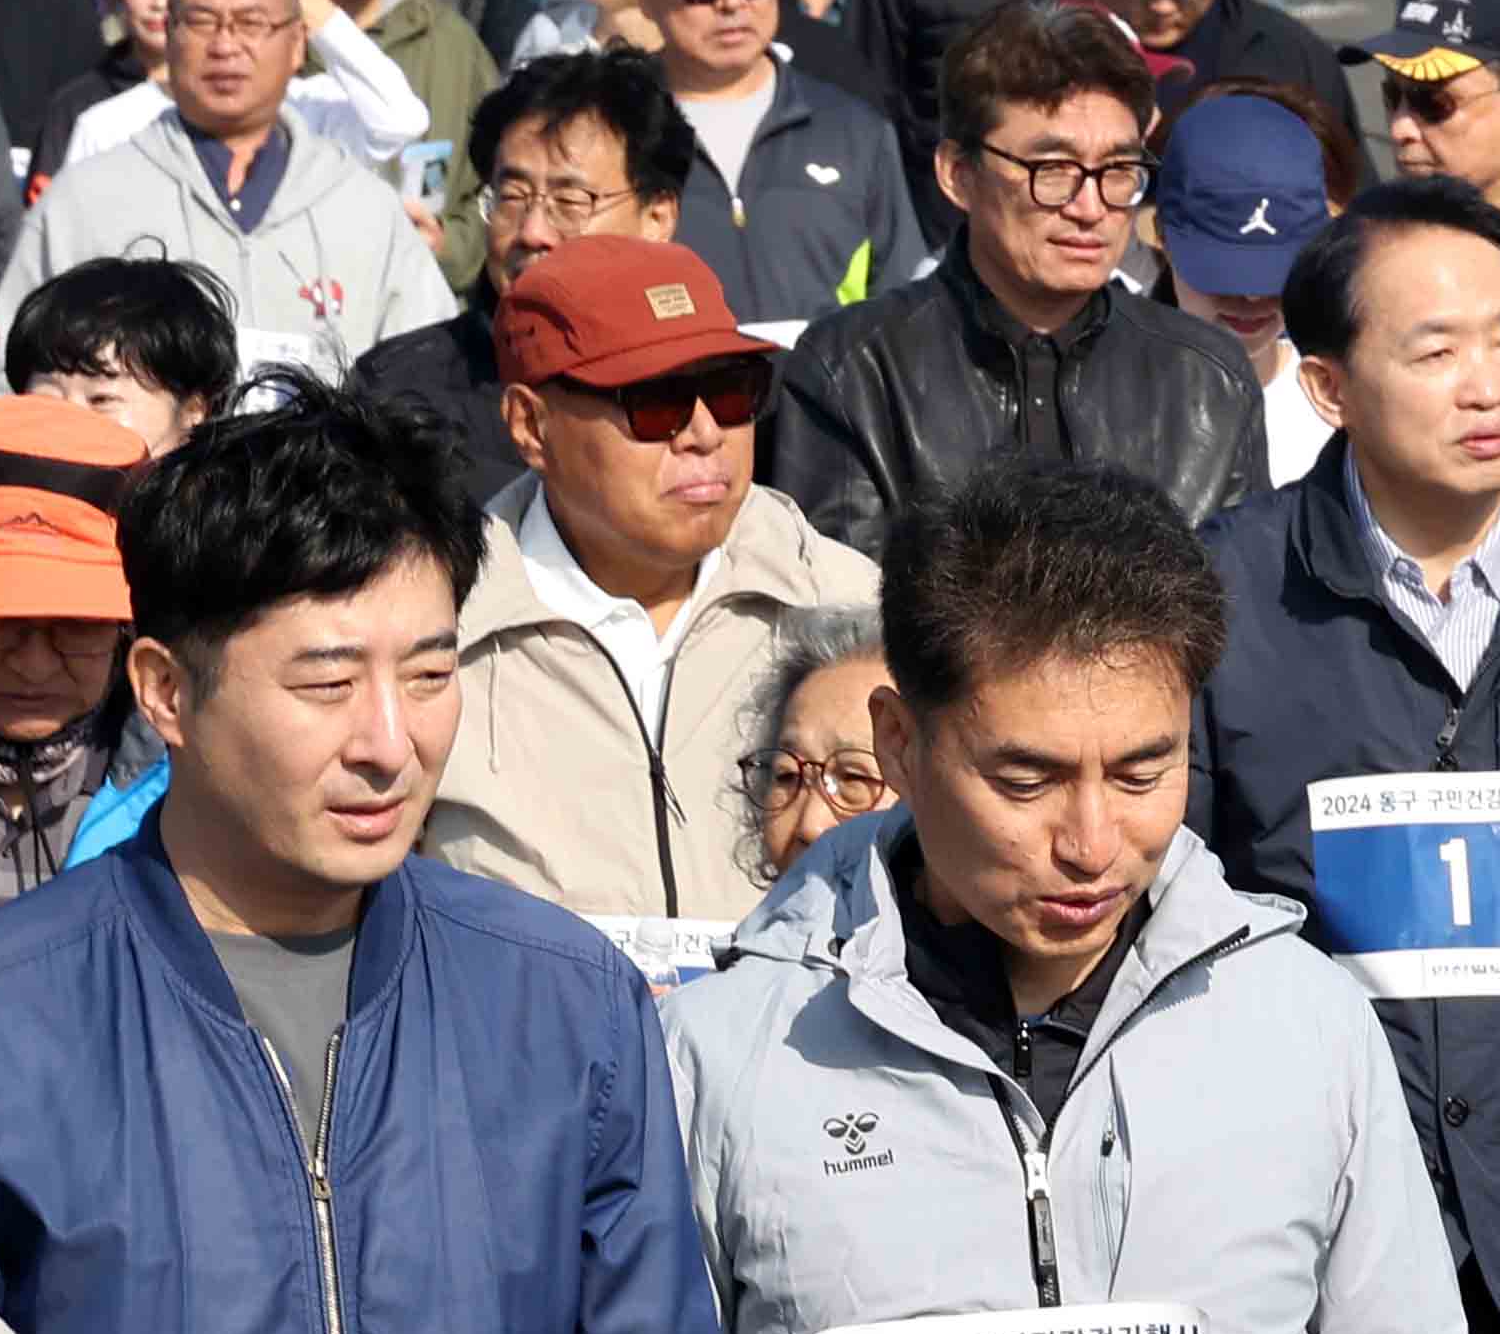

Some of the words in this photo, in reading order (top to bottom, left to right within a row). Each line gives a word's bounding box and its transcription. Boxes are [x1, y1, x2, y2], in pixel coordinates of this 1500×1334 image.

[1321, 795, 1372, 817] 2024
[1379, 791, 1417, 813] 동구
[1438, 837, 1472, 927] 1
[823, 1148, 895, 1177] hummel
